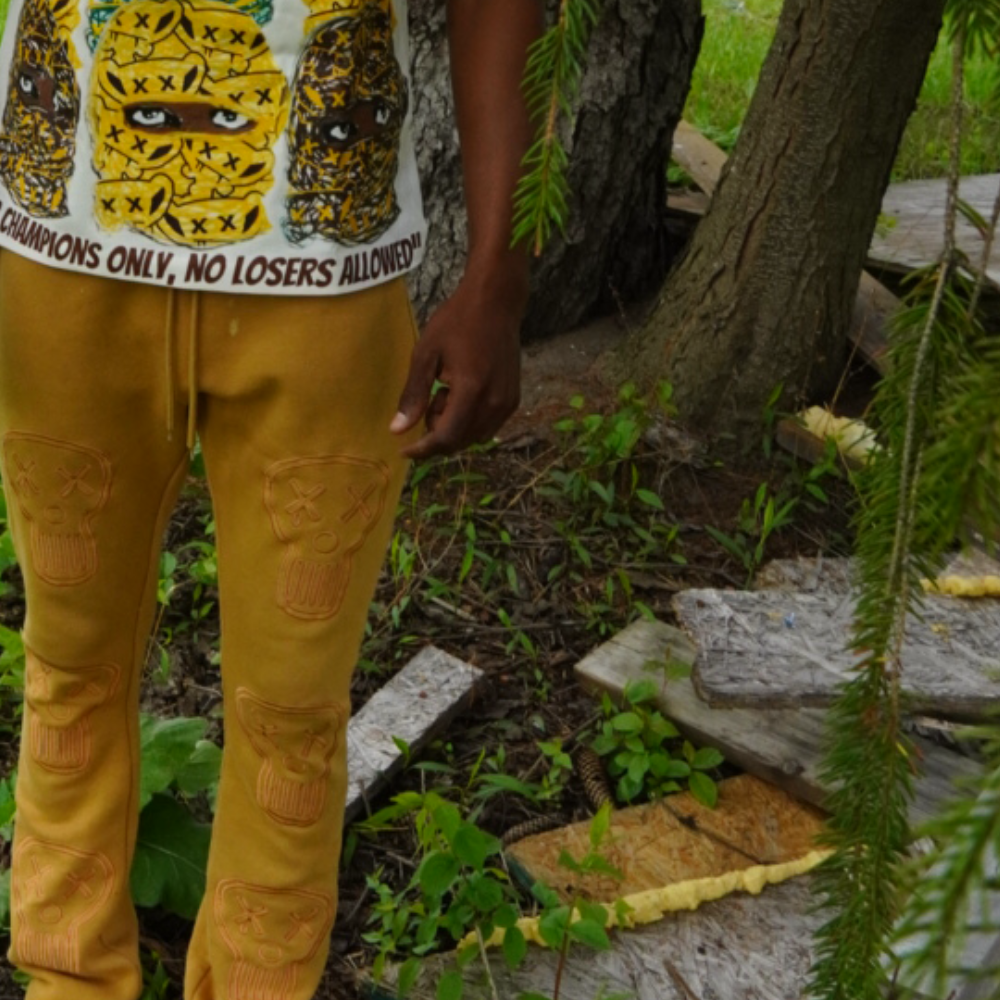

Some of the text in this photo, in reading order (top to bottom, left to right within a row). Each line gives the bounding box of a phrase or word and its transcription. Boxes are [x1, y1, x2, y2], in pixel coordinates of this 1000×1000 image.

[106, 245, 176, 286] ONLY,
[184, 253, 227, 284] NO
[231, 255, 337, 287] LOSERS
[338, 231, 422, 287] ALLOWED"
